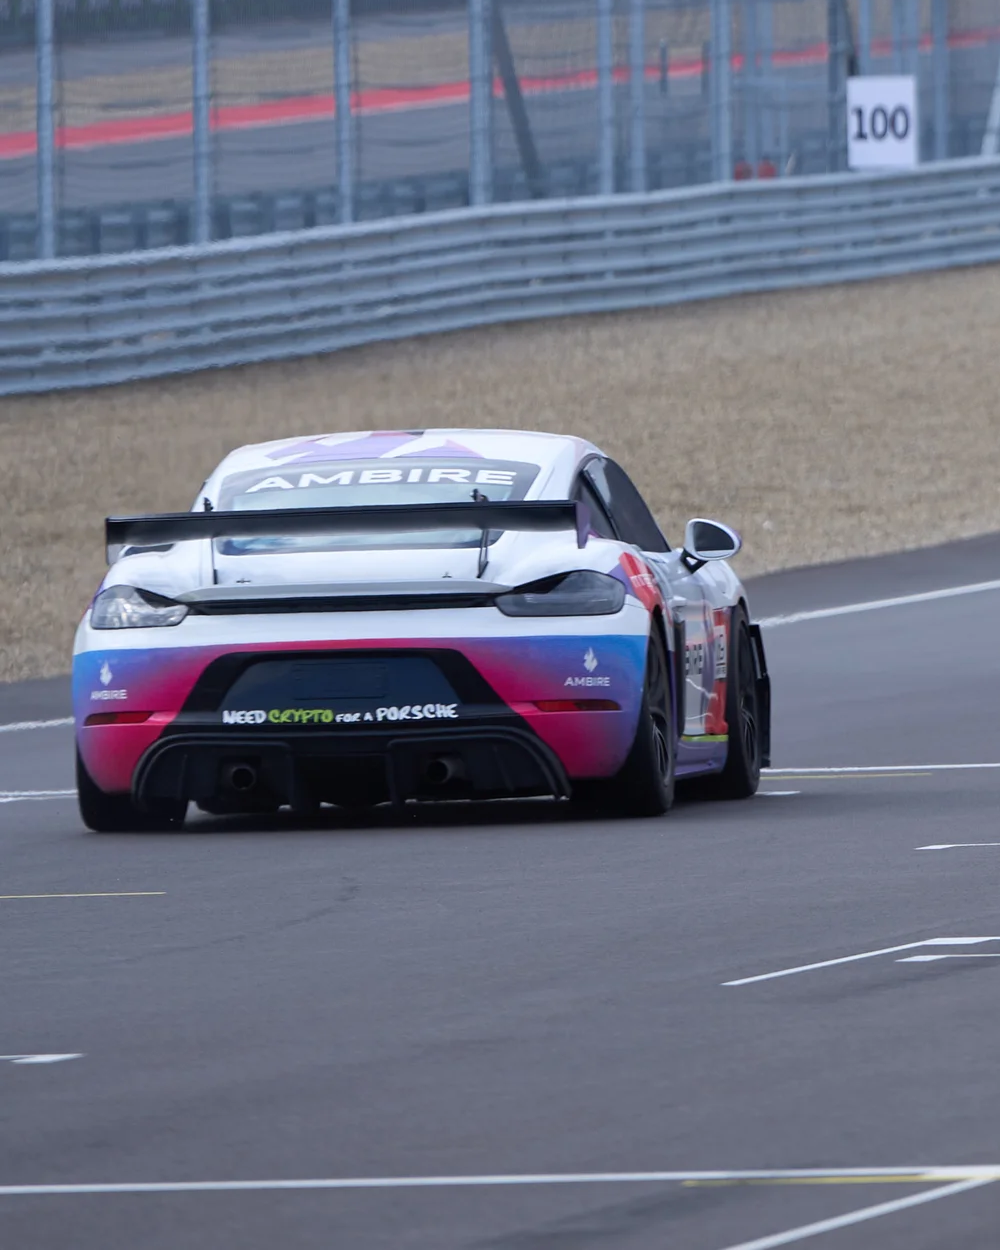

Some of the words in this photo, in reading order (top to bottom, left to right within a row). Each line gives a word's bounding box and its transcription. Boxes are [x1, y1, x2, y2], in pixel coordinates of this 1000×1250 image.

[851, 105, 909, 141] 100
[245, 468, 517, 493] AMBIRE
[564, 676, 611, 687] AMBIRE
[222, 710, 267, 724] NEED
[268, 709, 333, 723] CRYPTO
[335, 713, 361, 723] FOR
[363, 712, 374, 722] A
[376, 703, 459, 721] PORSCHE
